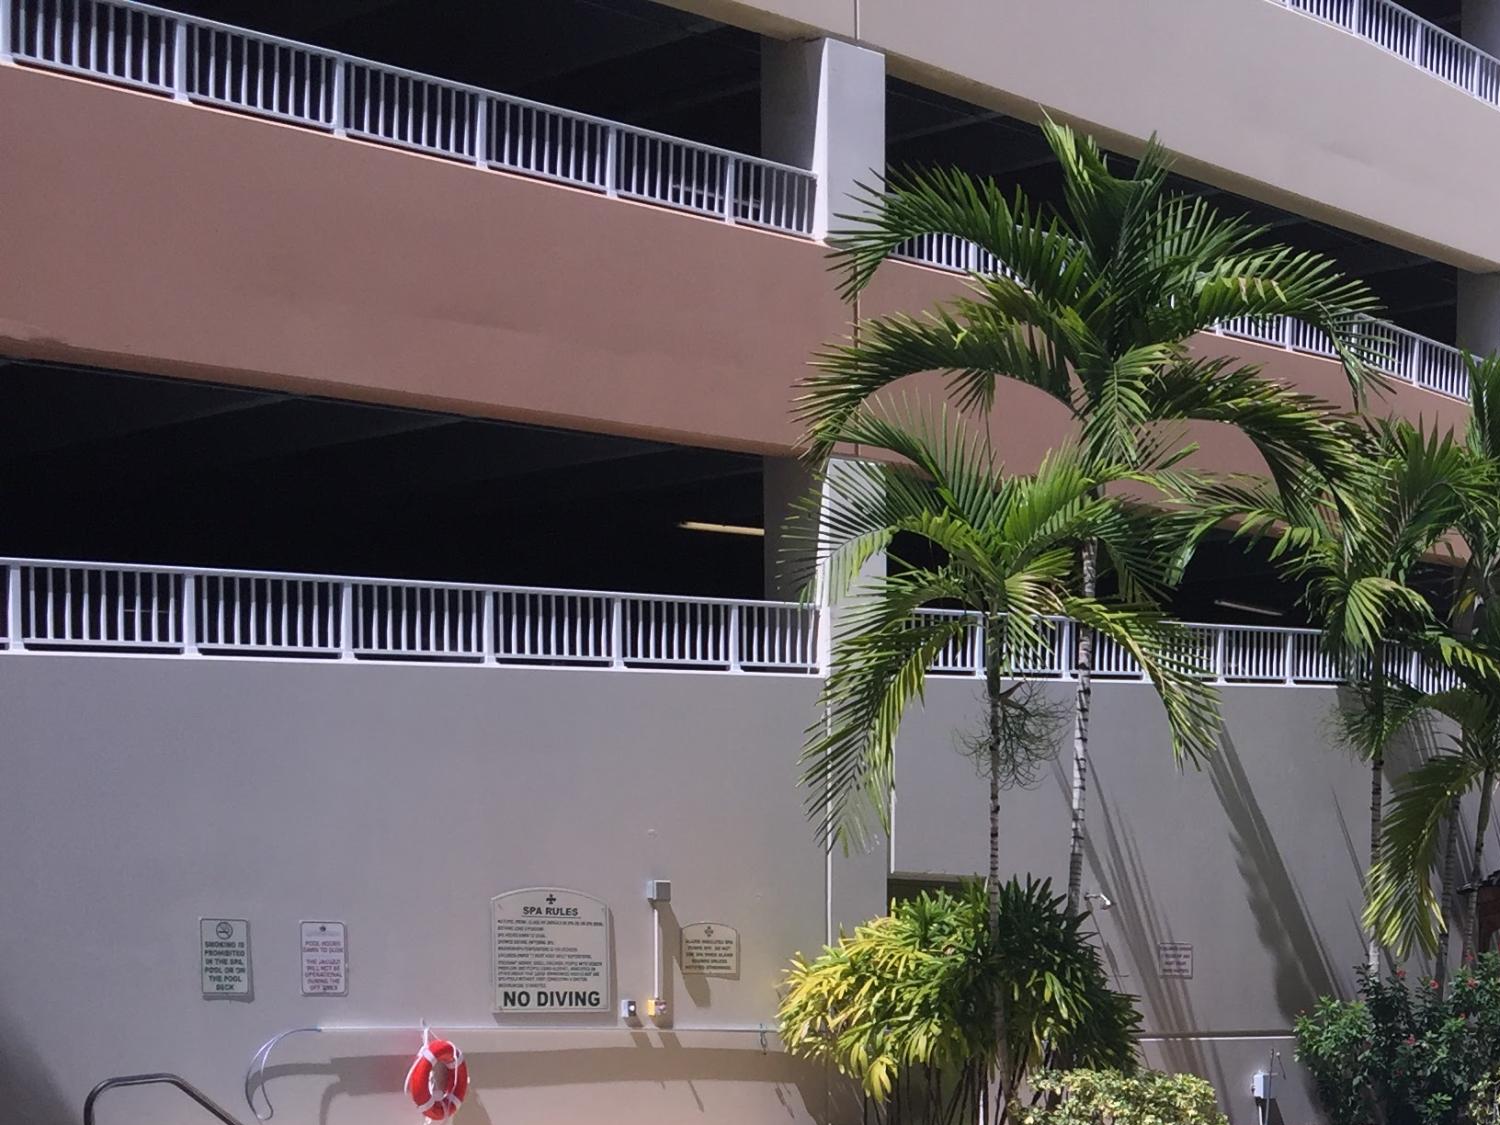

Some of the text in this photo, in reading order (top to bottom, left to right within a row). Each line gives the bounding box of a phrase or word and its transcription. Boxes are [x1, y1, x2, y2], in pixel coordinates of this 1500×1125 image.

[523, 906, 578, 916] SPA RULES
[504, 991, 600, 1007] NO DIVING
